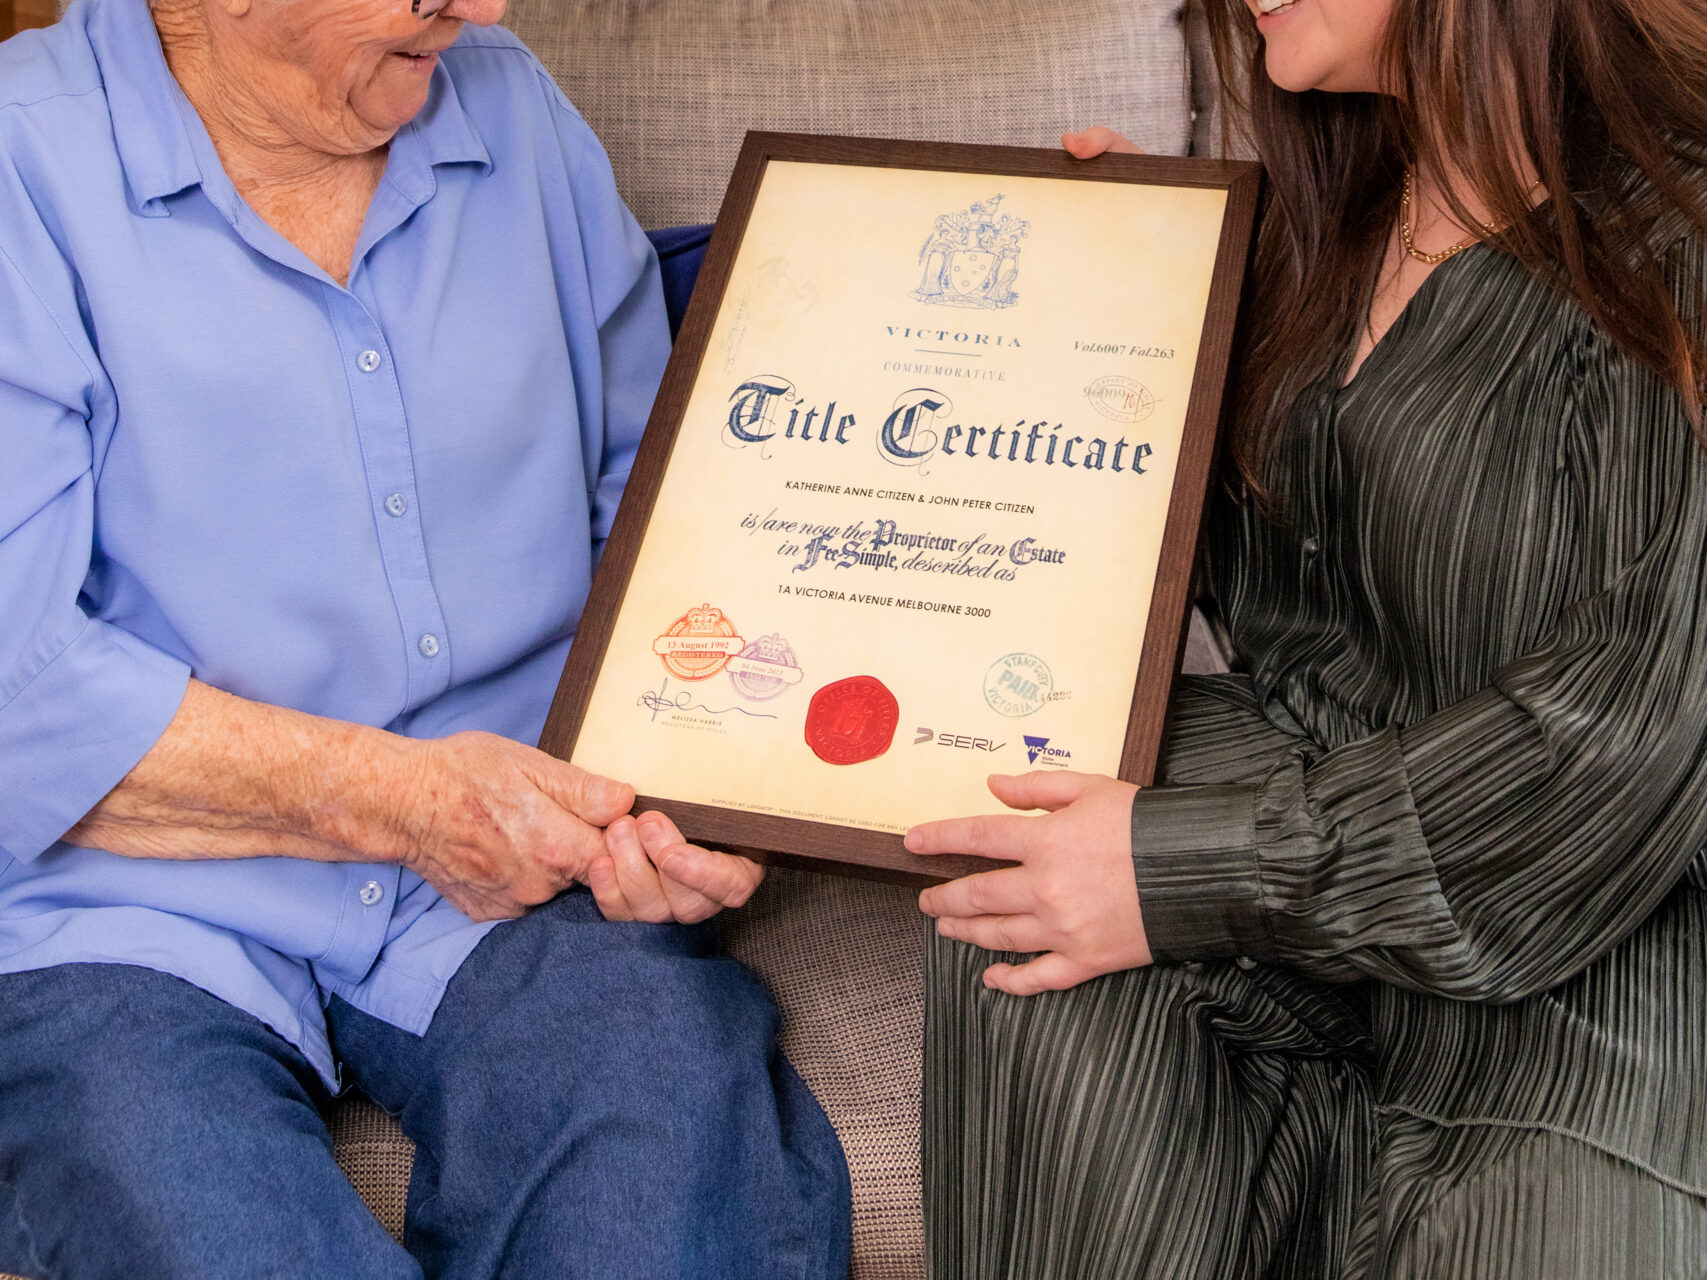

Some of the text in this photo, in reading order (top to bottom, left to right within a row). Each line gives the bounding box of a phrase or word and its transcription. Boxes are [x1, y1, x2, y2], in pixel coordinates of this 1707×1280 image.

[886, 325, 1021, 348] VICTORIA
[1074, 341, 1175, 359] Vol.6007 Fol.263
[883, 360, 1006, 382] COMMEMORATIVE
[721, 375, 1153, 476] Title Certificate
[785, 481, 1035, 514] KATHERINE ANNE CITIZEN & JOHN PETER CITIZEN
[799, 523, 841, 537] now
[841, 521, 871, 541] the
[869, 519, 957, 552] Proprietor
[952, 533, 986, 560] of
[976, 543, 1007, 557] an
[1009, 537, 1066, 565] Estate
[777, 540, 801, 556] in
[901, 551, 998, 579] described
[993, 567, 1019, 581] as
[777, 585, 991, 618] 1A VICTORIA AVENUE MELBOURNE 3000
[667, 641, 729, 650] 13 August 1992
[1003, 656, 1037, 669] STAMP
[996, 669, 1040, 700] PAID
[987, 686, 1033, 714] VICTORIA
[937, 733, 1006, 752] SERV
[1026, 744, 1072, 759] VICTORIA
